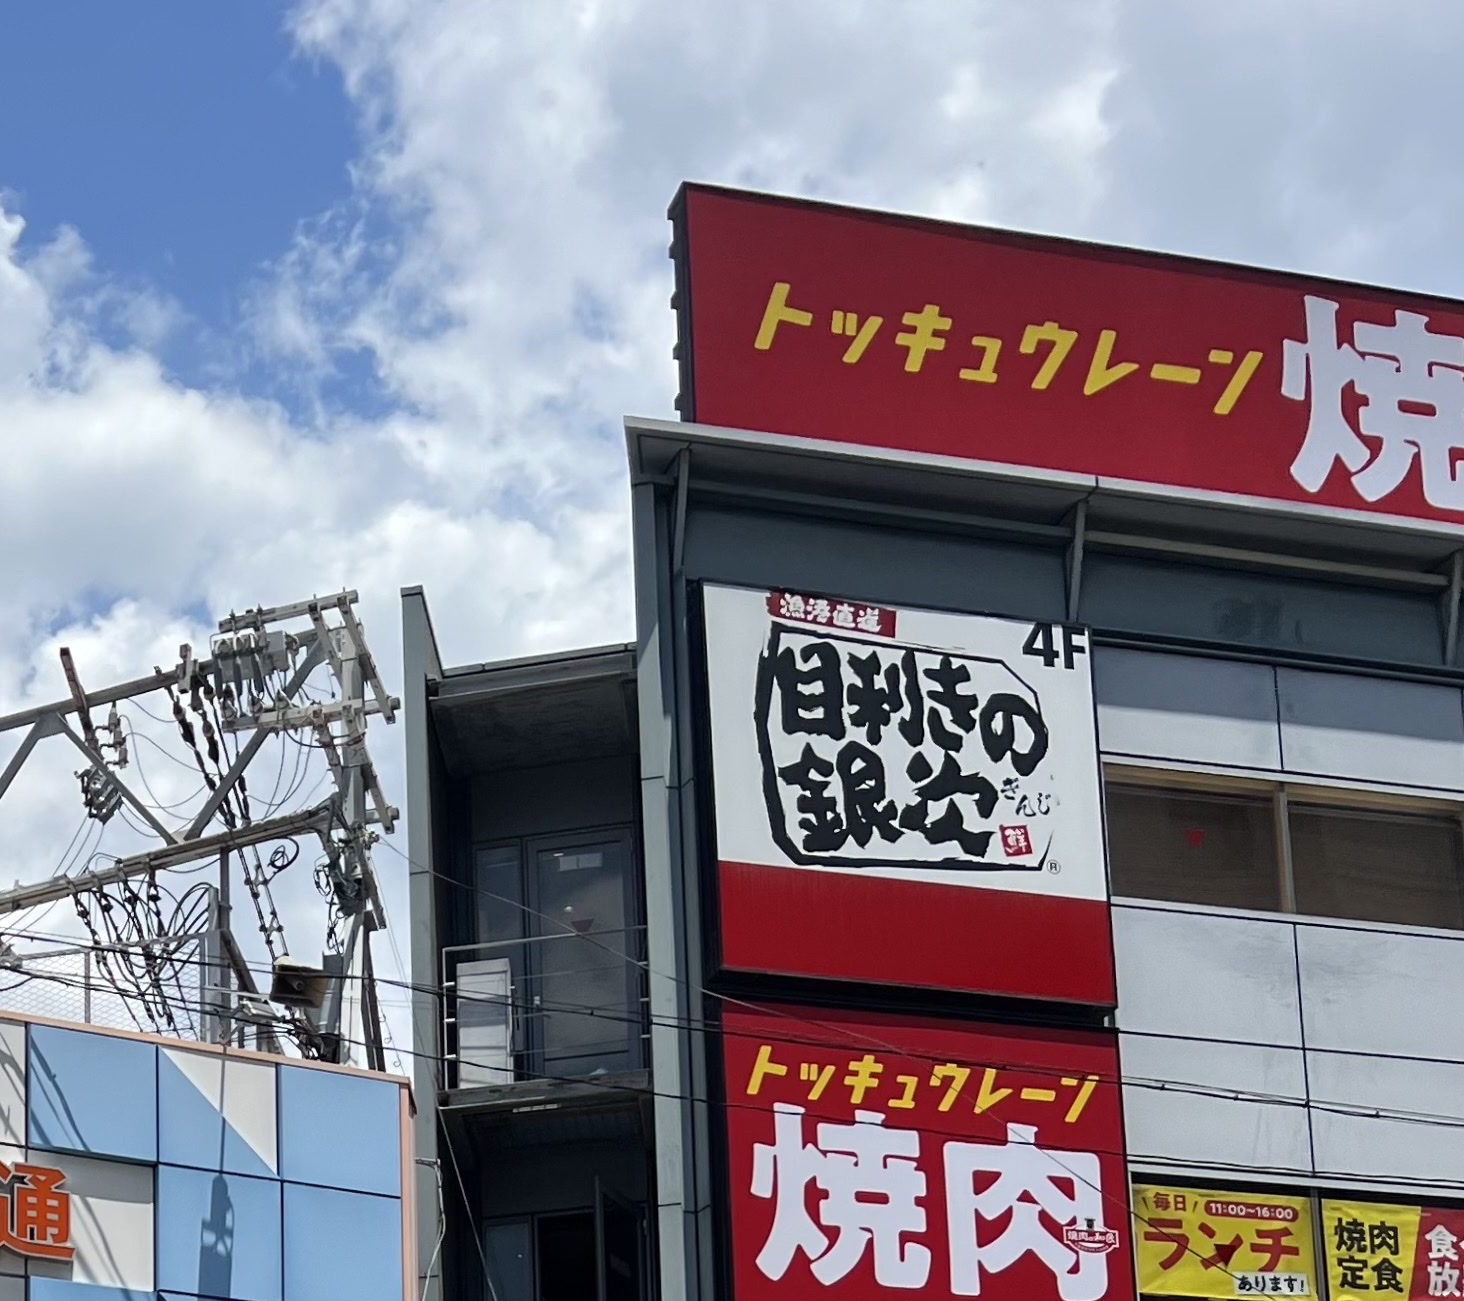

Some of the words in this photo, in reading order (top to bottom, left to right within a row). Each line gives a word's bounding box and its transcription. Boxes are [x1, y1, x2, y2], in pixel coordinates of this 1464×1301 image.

[754, 282, 1263, 415] トッキュウレーン
[779, 593, 882, 633] 漁港直送
[1022, 622, 1087, 670] 4F
[774, 641, 1049, 776] 目利きの
[779, 742, 999, 856] 銀次
[1000, 777, 1051, 817] ぎんじ
[747, 1044, 1101, 1124] トッキュウレーン
[1153, 1191, 1187, 1213] 毎日
[1143, 1217, 1300, 1273] ランチ
[1334, 1217, 1400, 1256] 焼肉
[1425, 1224, 1464, 1261] 食
[1336, 1254, 1404, 1293] 定食
[1427, 1261, 1464, 1297] 放
